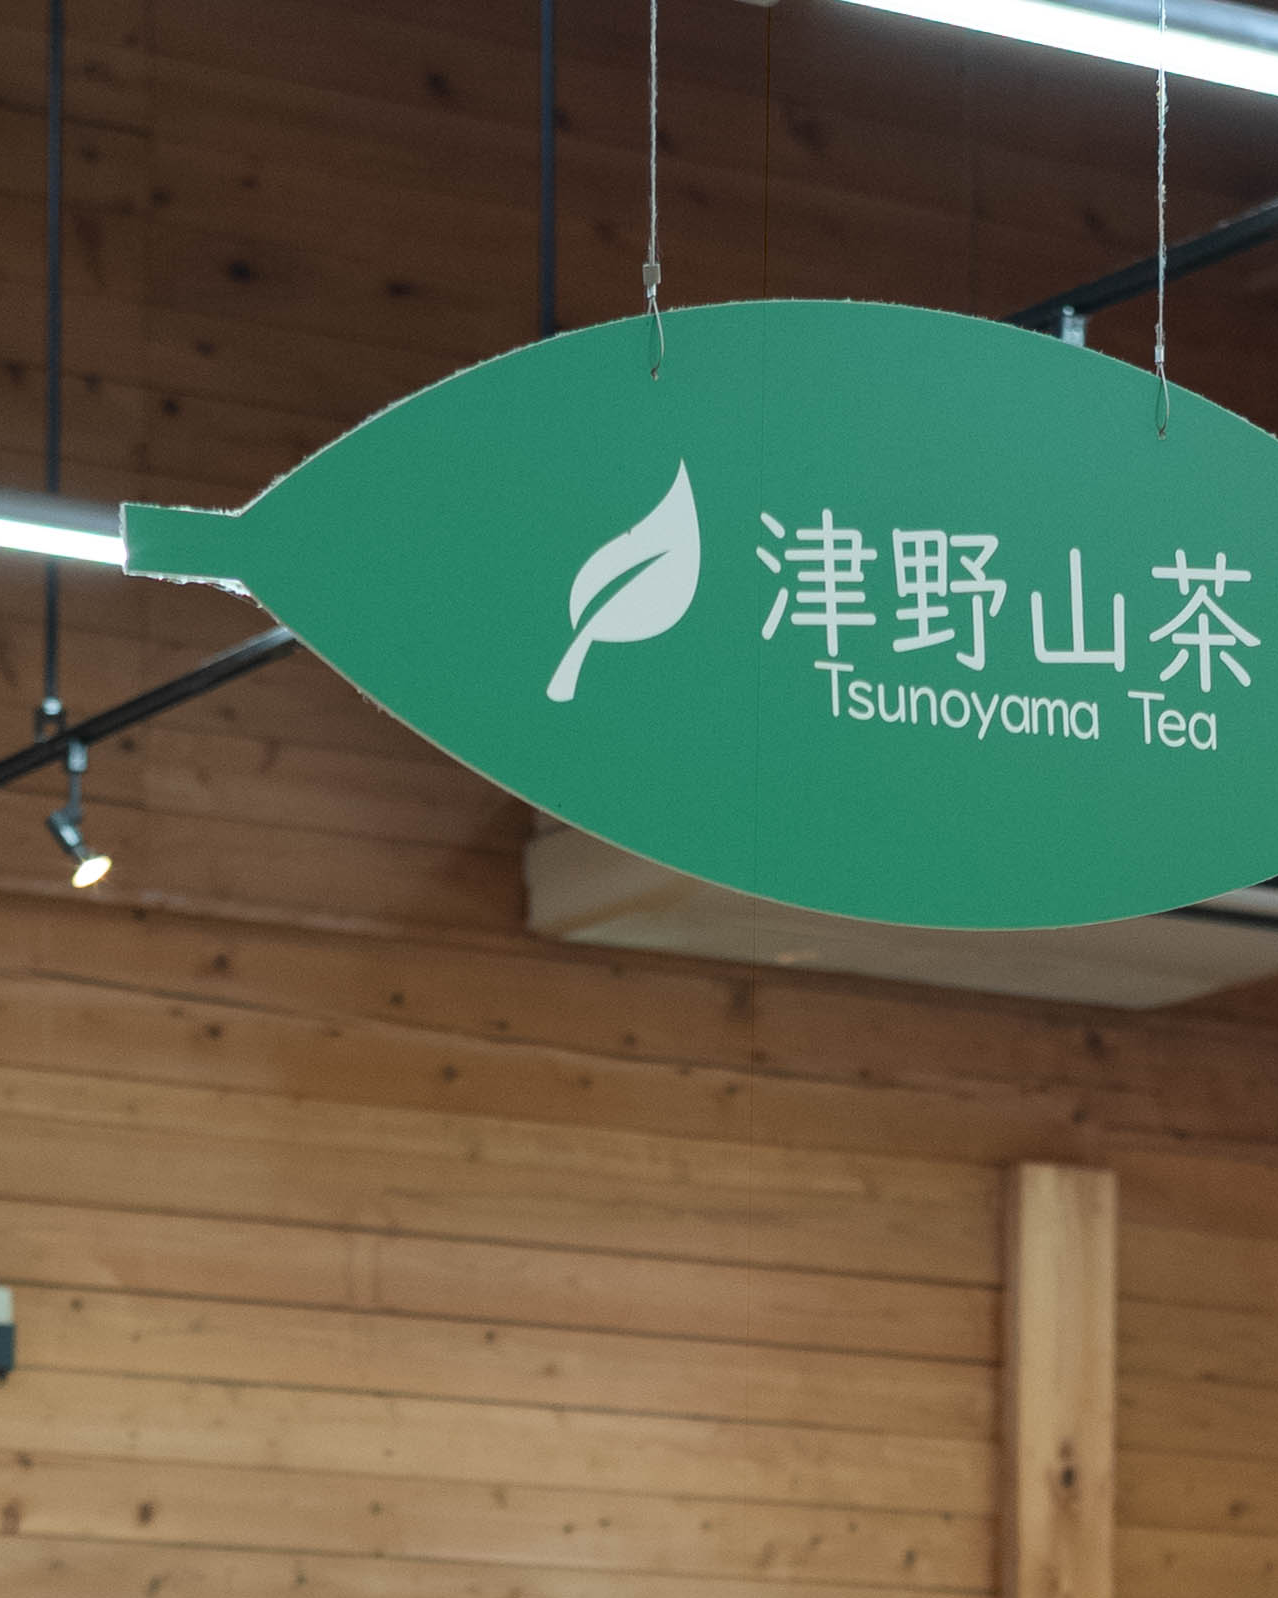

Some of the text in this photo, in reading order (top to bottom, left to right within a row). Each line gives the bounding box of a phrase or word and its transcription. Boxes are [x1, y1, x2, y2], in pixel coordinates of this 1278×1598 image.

[756, 509, 1261, 692] 津野山茶
[814, 660, 1217, 750] Tsunoyama Tea
